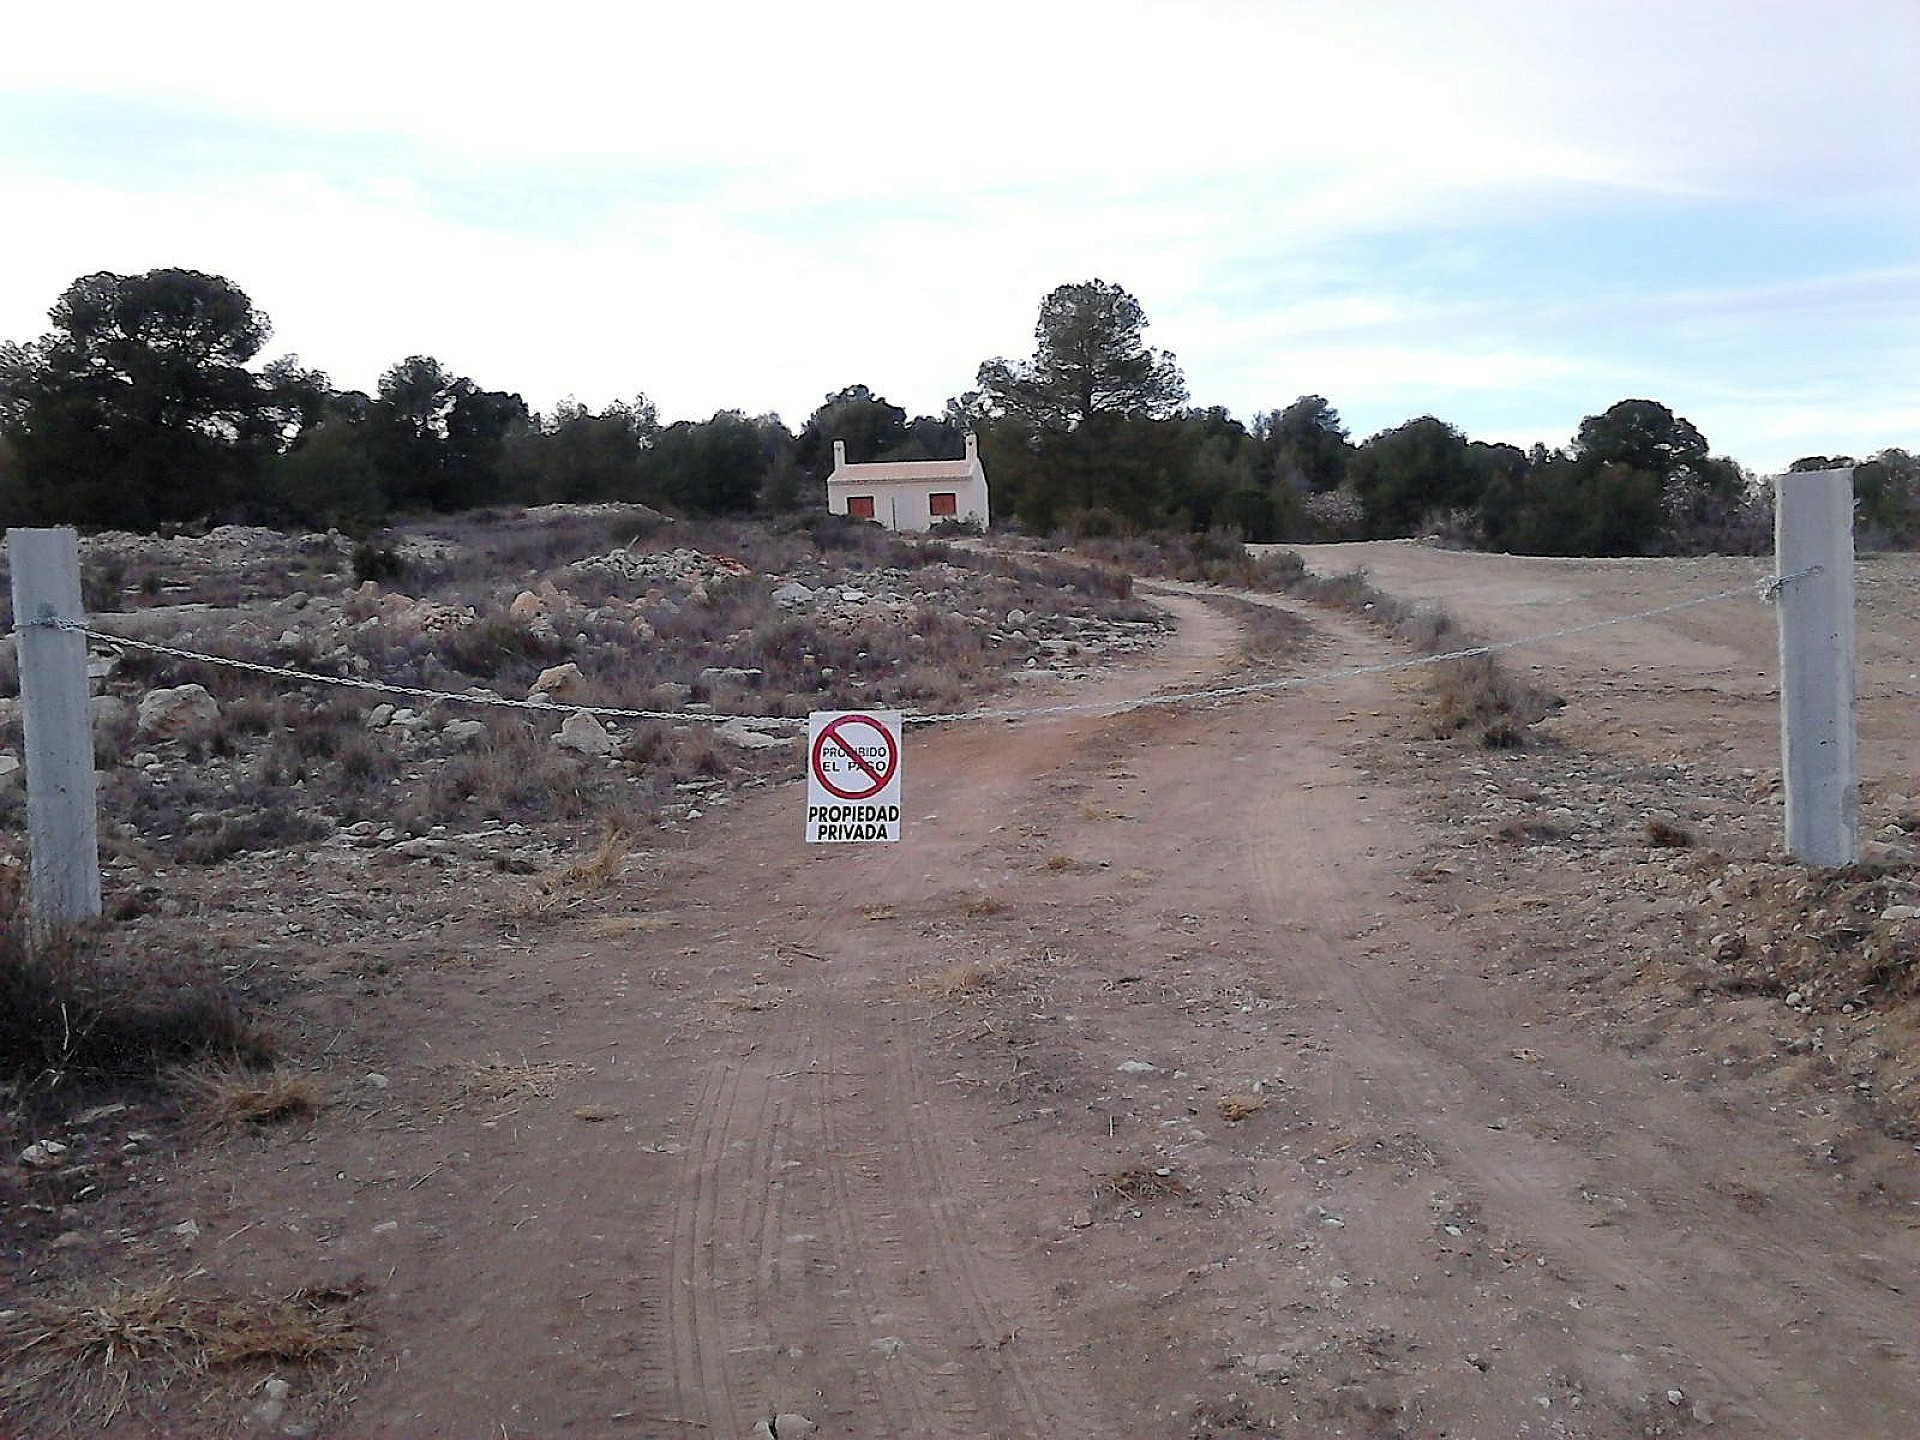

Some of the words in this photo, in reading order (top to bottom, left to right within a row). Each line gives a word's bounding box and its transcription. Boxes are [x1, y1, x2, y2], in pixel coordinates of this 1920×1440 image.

[823, 747, 886, 757] PROIBIDO
[823, 762, 840, 771] EL
[809, 806, 899, 822] PROPIEDAD
[818, 824, 887, 840] PRIVADA
